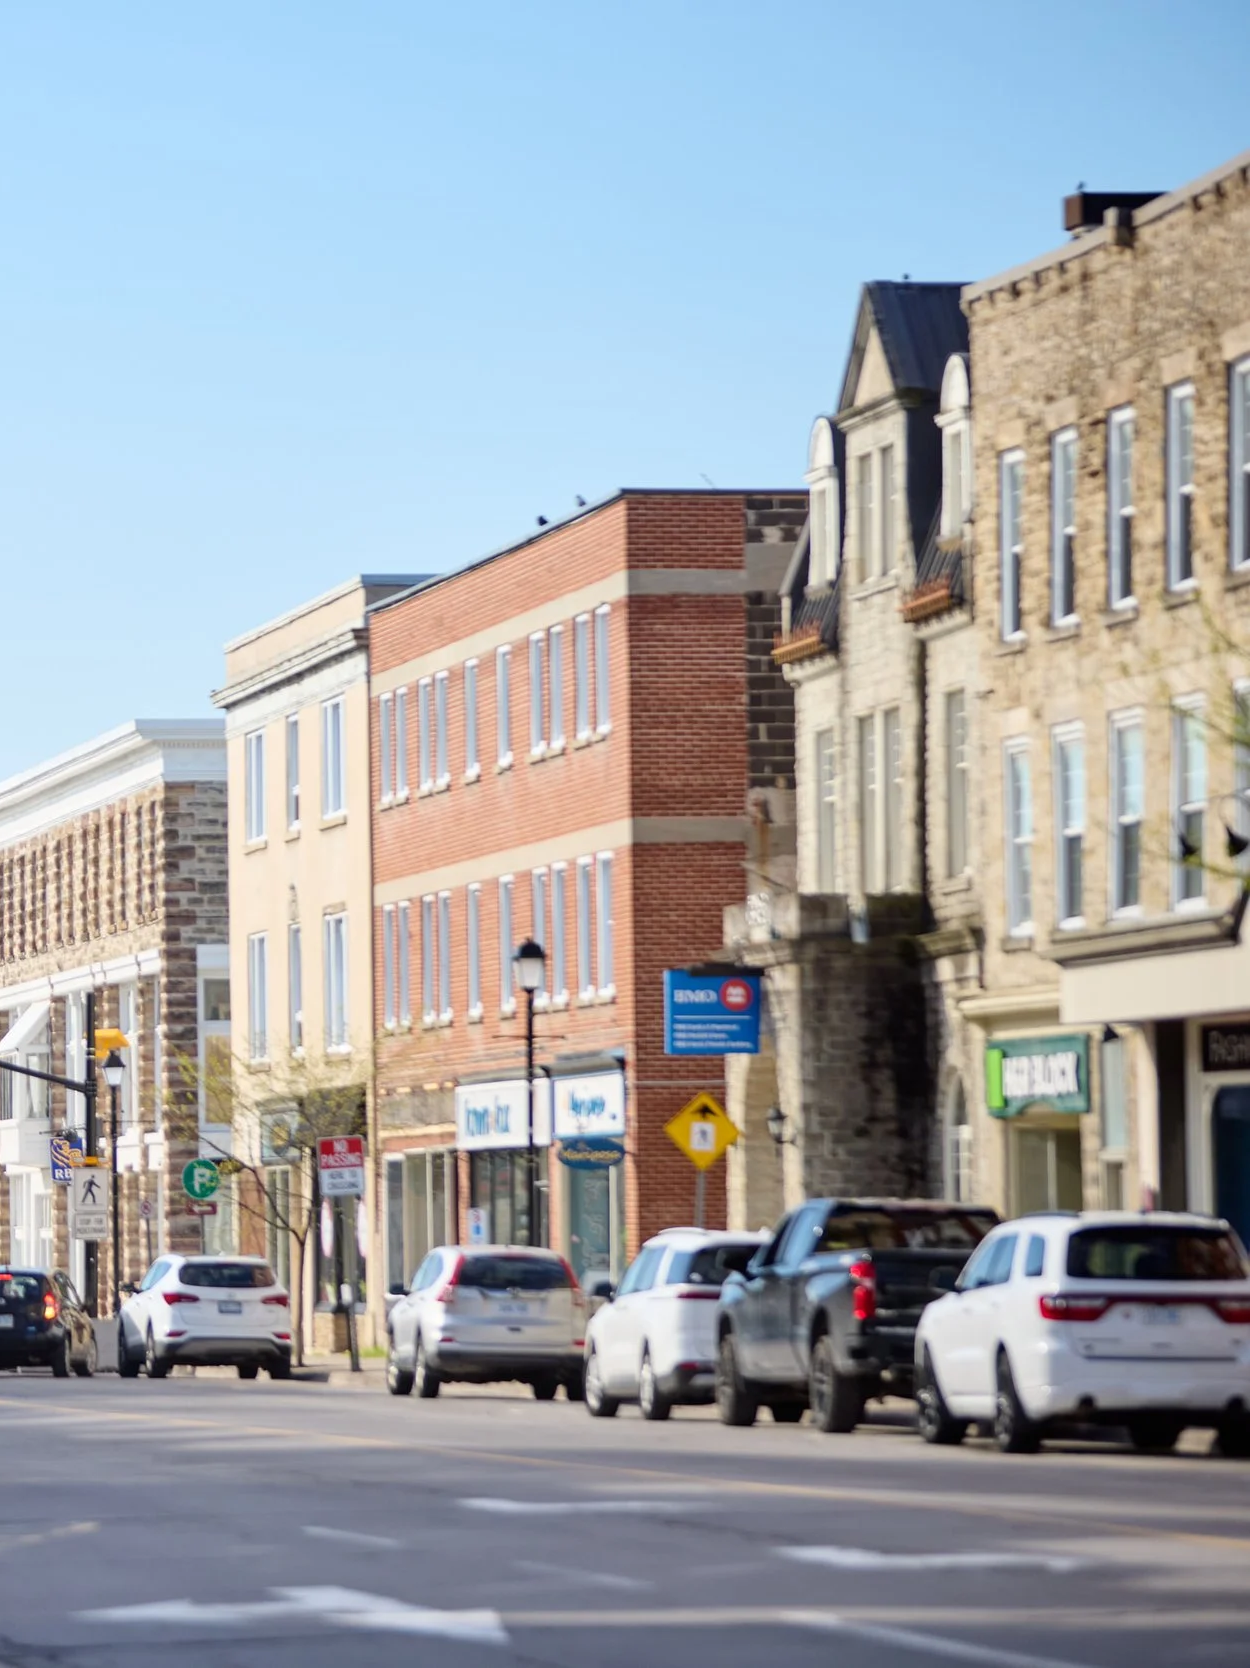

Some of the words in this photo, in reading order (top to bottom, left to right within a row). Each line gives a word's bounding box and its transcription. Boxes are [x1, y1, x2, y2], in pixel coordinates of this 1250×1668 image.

[673, 989, 718, 1004] BMO
[333, 1139, 348, 1152] NO
[321, 1152, 362, 1168] PASSING
[55, 1169, 72, 1180] RB
